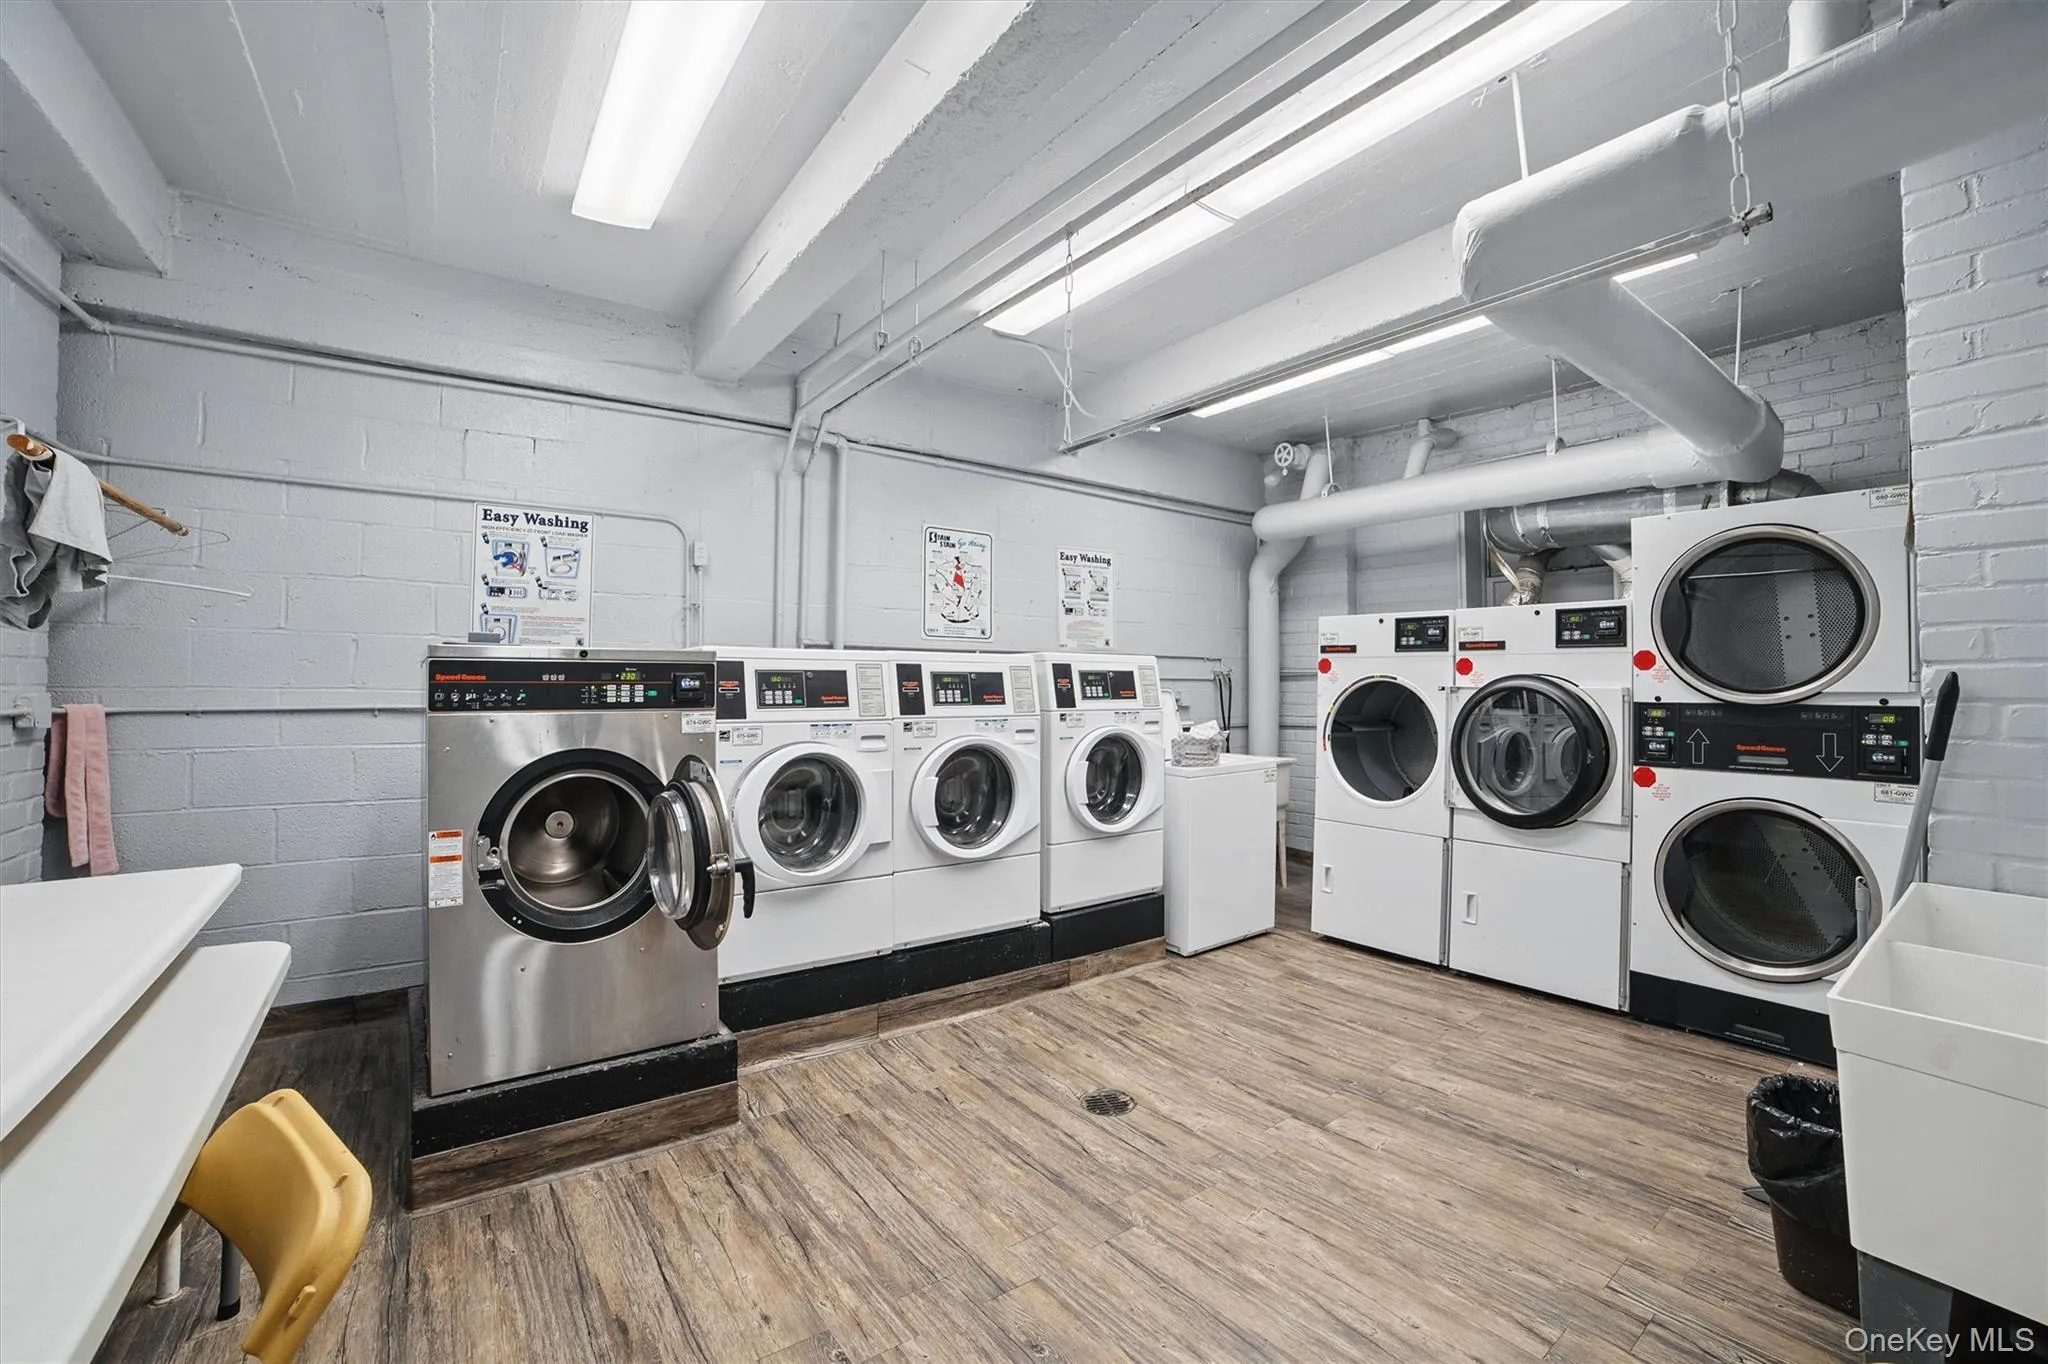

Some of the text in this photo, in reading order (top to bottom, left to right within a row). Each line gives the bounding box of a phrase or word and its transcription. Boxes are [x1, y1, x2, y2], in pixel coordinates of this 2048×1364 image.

[481, 508, 589, 533] Easy Washing
[1059, 551, 1078, 564] Easy
[1079, 553, 1112, 567] Washing
[435, 673, 486, 682] Speed Queen
